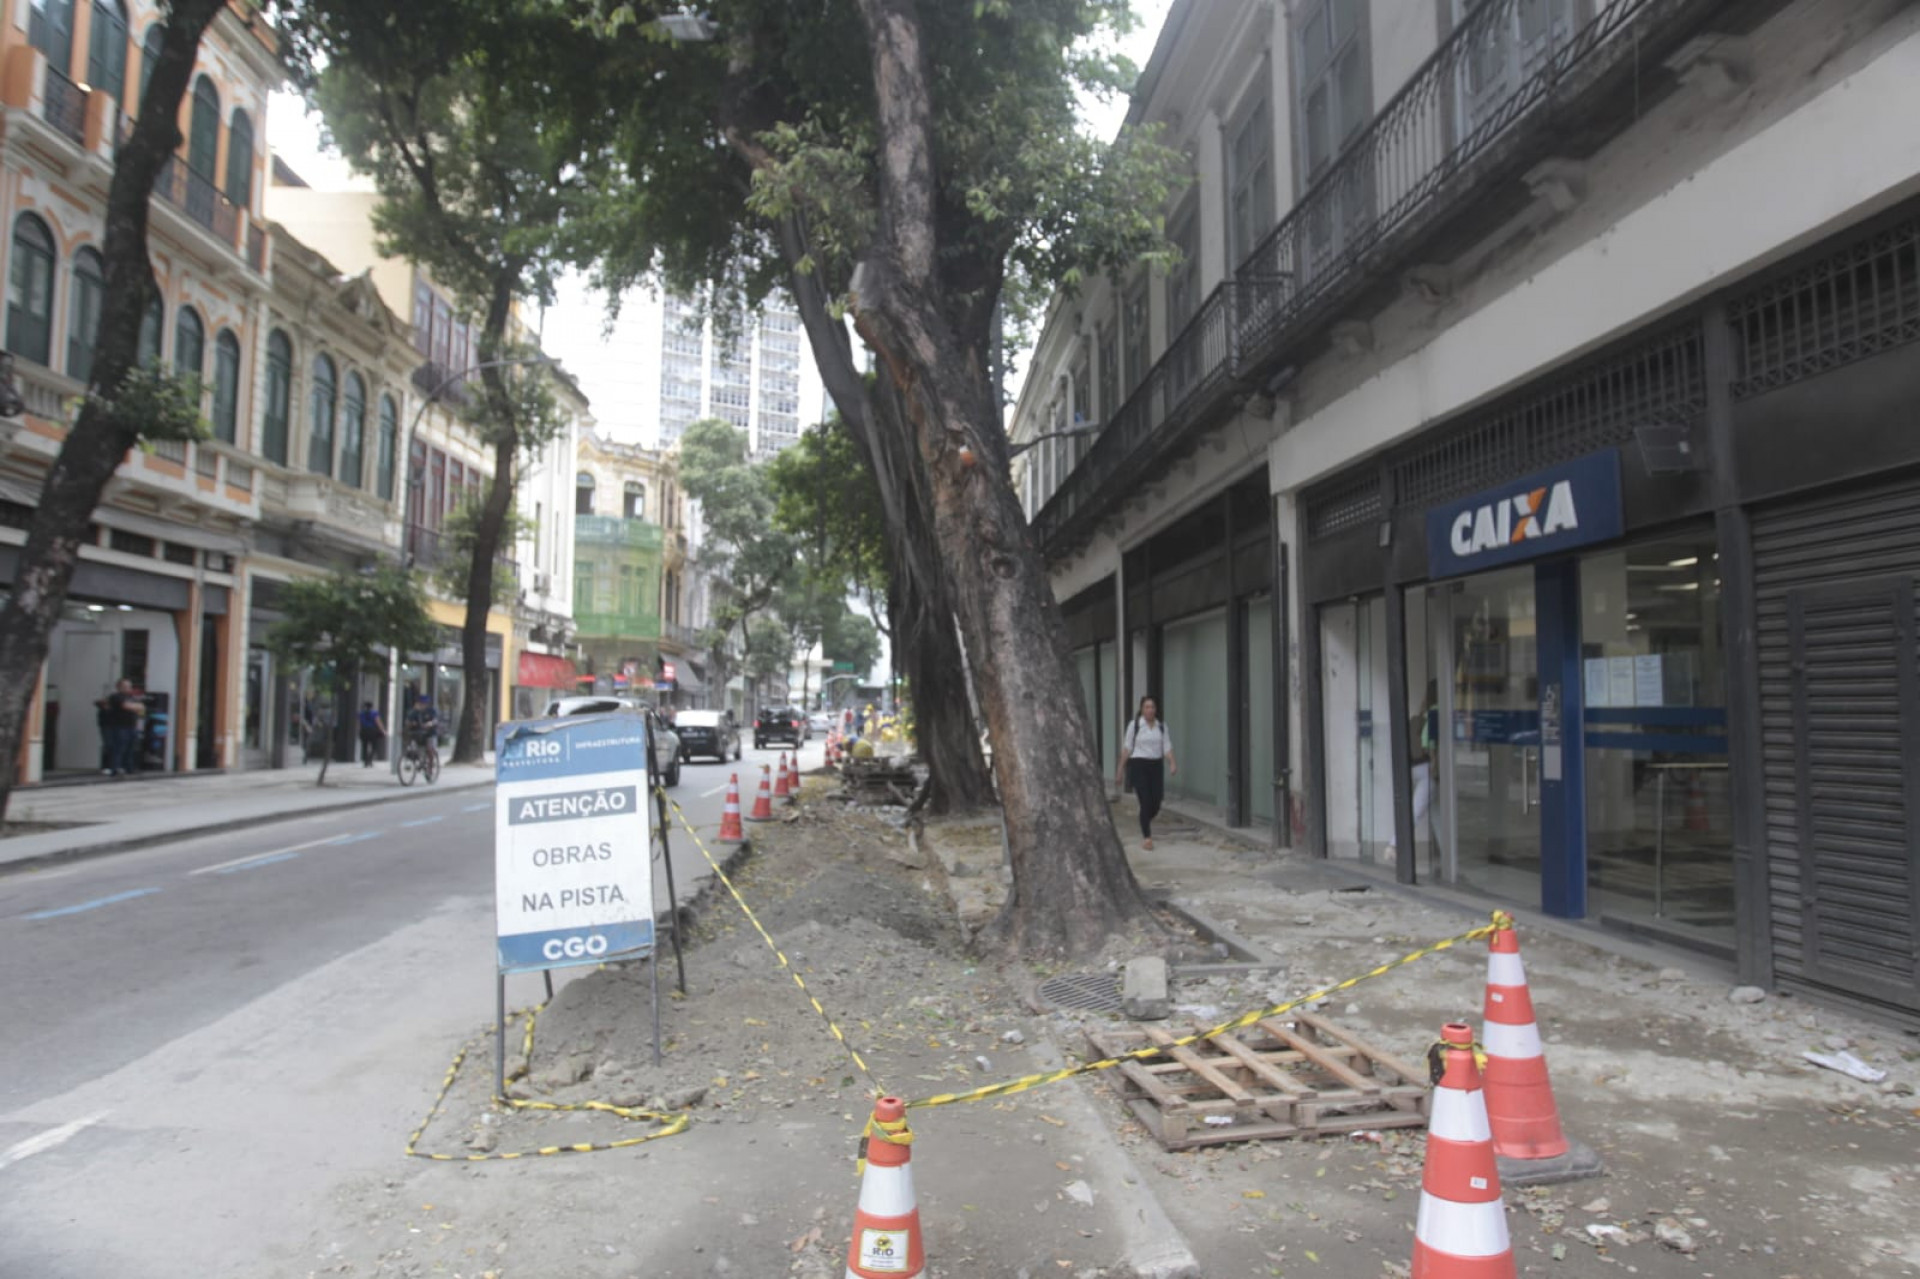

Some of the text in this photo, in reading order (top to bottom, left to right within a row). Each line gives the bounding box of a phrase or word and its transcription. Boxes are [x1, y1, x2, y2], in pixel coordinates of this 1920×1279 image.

[1450, 480, 1578, 556] CAIXA
[526, 740, 561, 758] Rio
[519, 791, 626, 819] ATENÇÃO
[533, 842, 612, 867] OBRAS
[522, 884, 624, 912] NA PISTA
[543, 935, 608, 960] CGO
